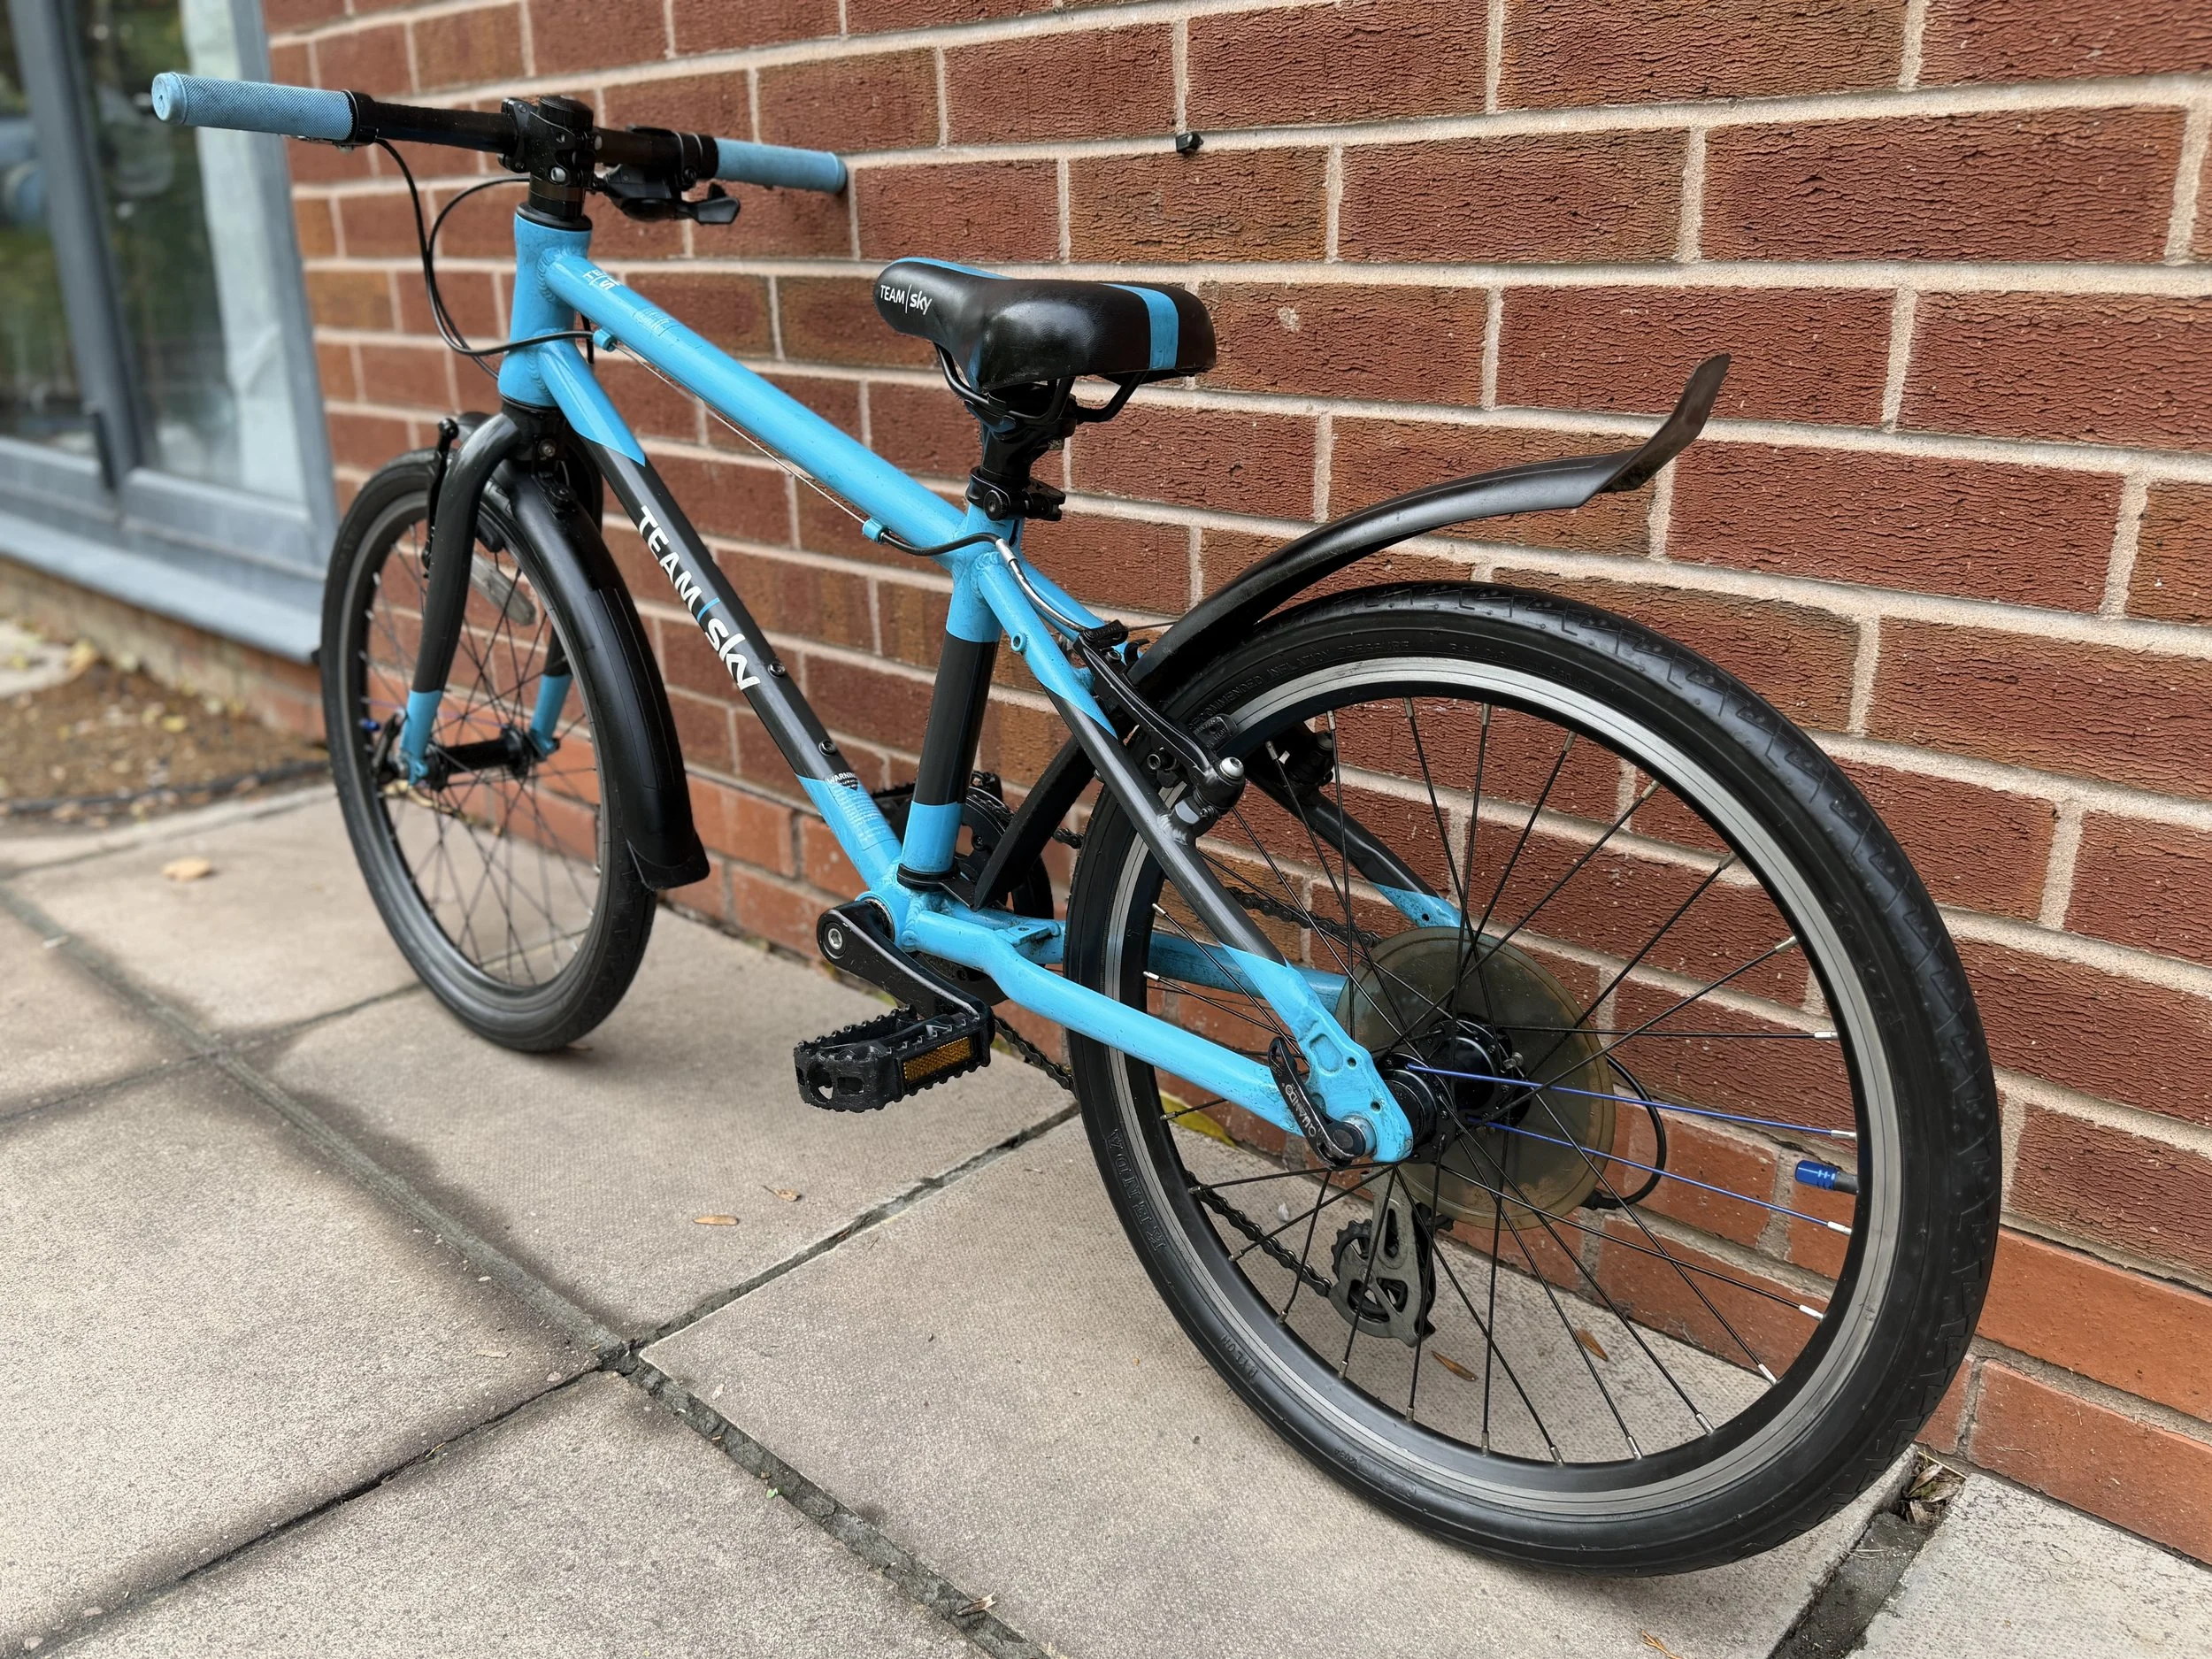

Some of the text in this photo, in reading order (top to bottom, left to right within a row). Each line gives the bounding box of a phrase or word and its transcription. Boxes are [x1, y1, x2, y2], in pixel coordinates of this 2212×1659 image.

[880, 284, 932, 315] TEAM sky
[639, 505, 761, 691] TEAM sky
[1285, 1084, 1317, 1137] QUANDO
[1108, 1128, 1167, 1253] KENDA
